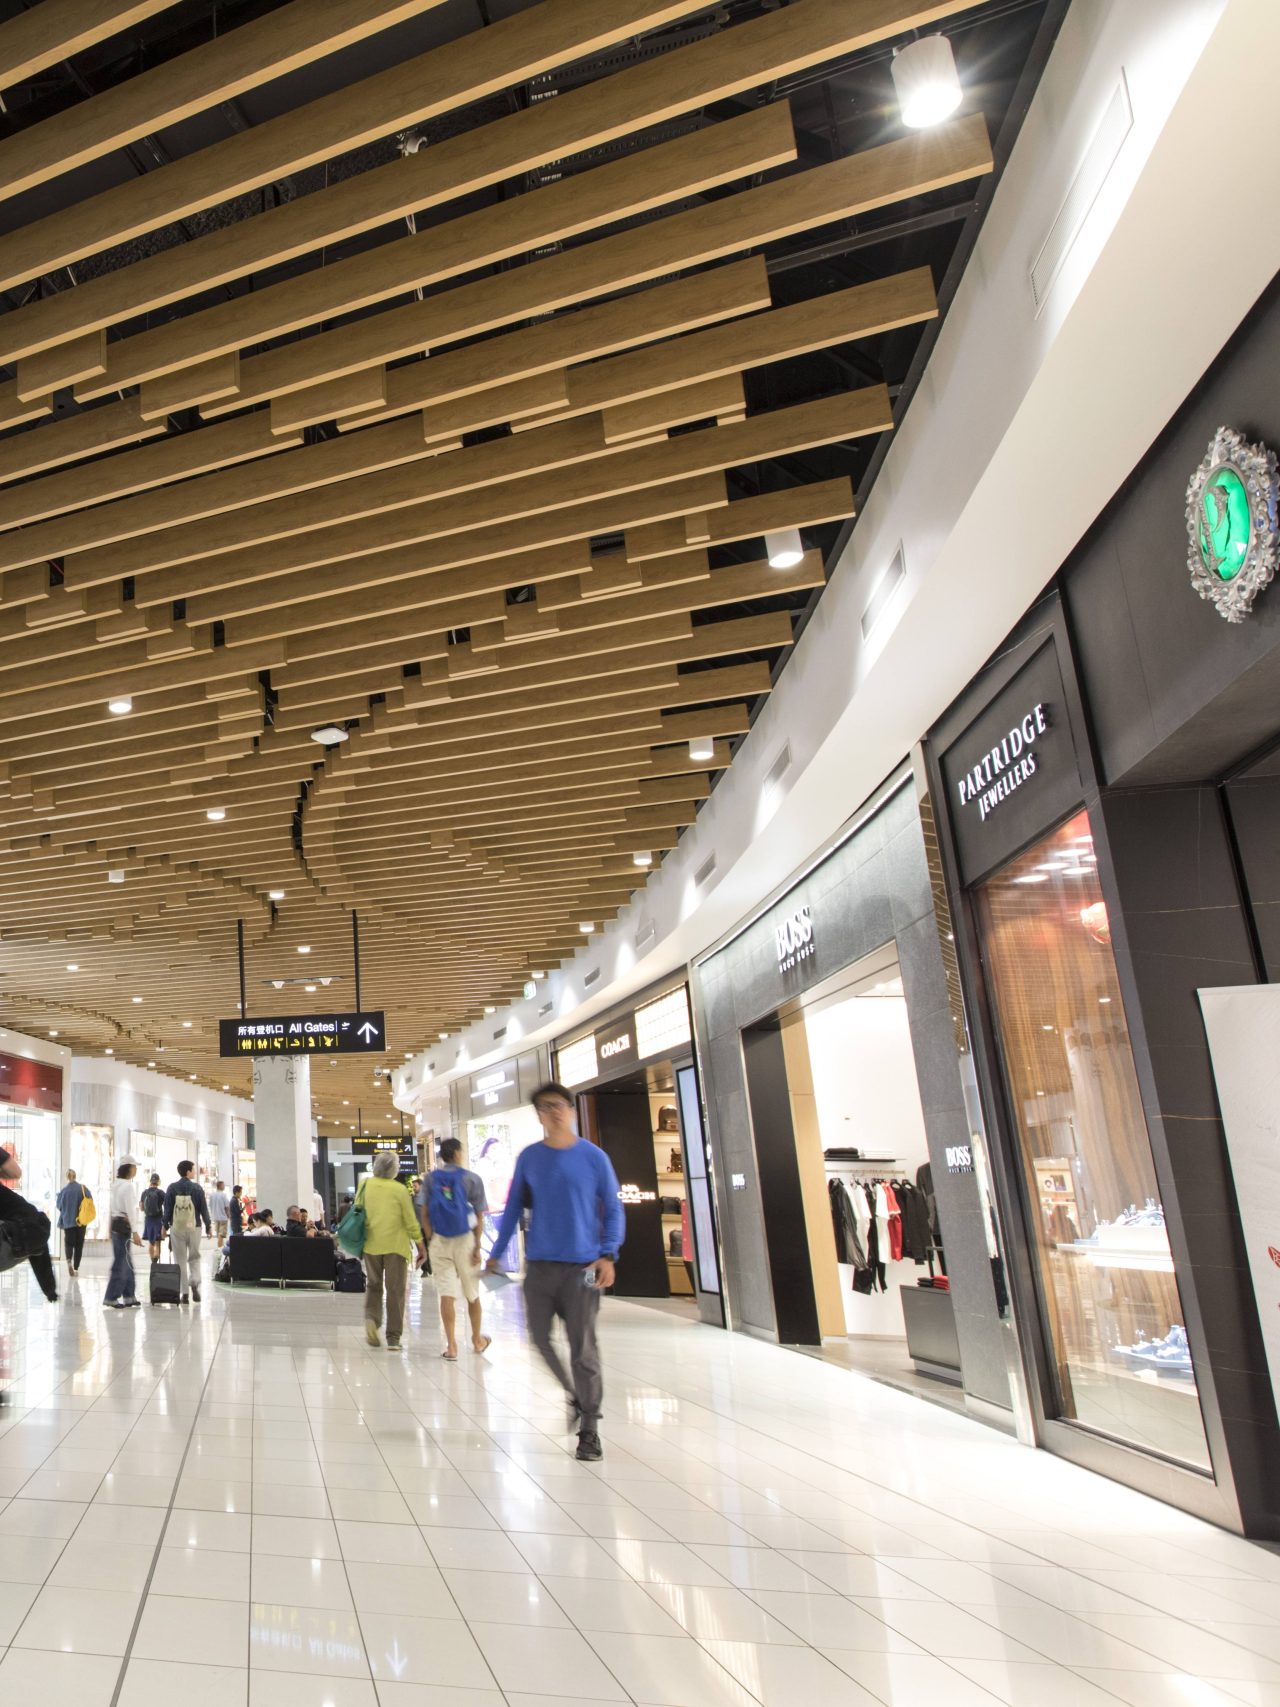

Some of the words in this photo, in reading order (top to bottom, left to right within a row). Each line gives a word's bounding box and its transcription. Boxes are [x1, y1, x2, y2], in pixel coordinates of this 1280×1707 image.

[958, 703, 1046, 806] PARTRIDGE
[978, 752, 1036, 822] JEWELLERS
[775, 905, 812, 962] BOSS
[237, 1024, 284, 1036] 所有登机口
[289, 1023, 302, 1034] All
[304, 1022, 335, 1033] Gates
[600, 1033, 631, 1059] COACH
[945, 1145, 971, 1167] BOSS
[616, 1191, 656, 1200] OACH
